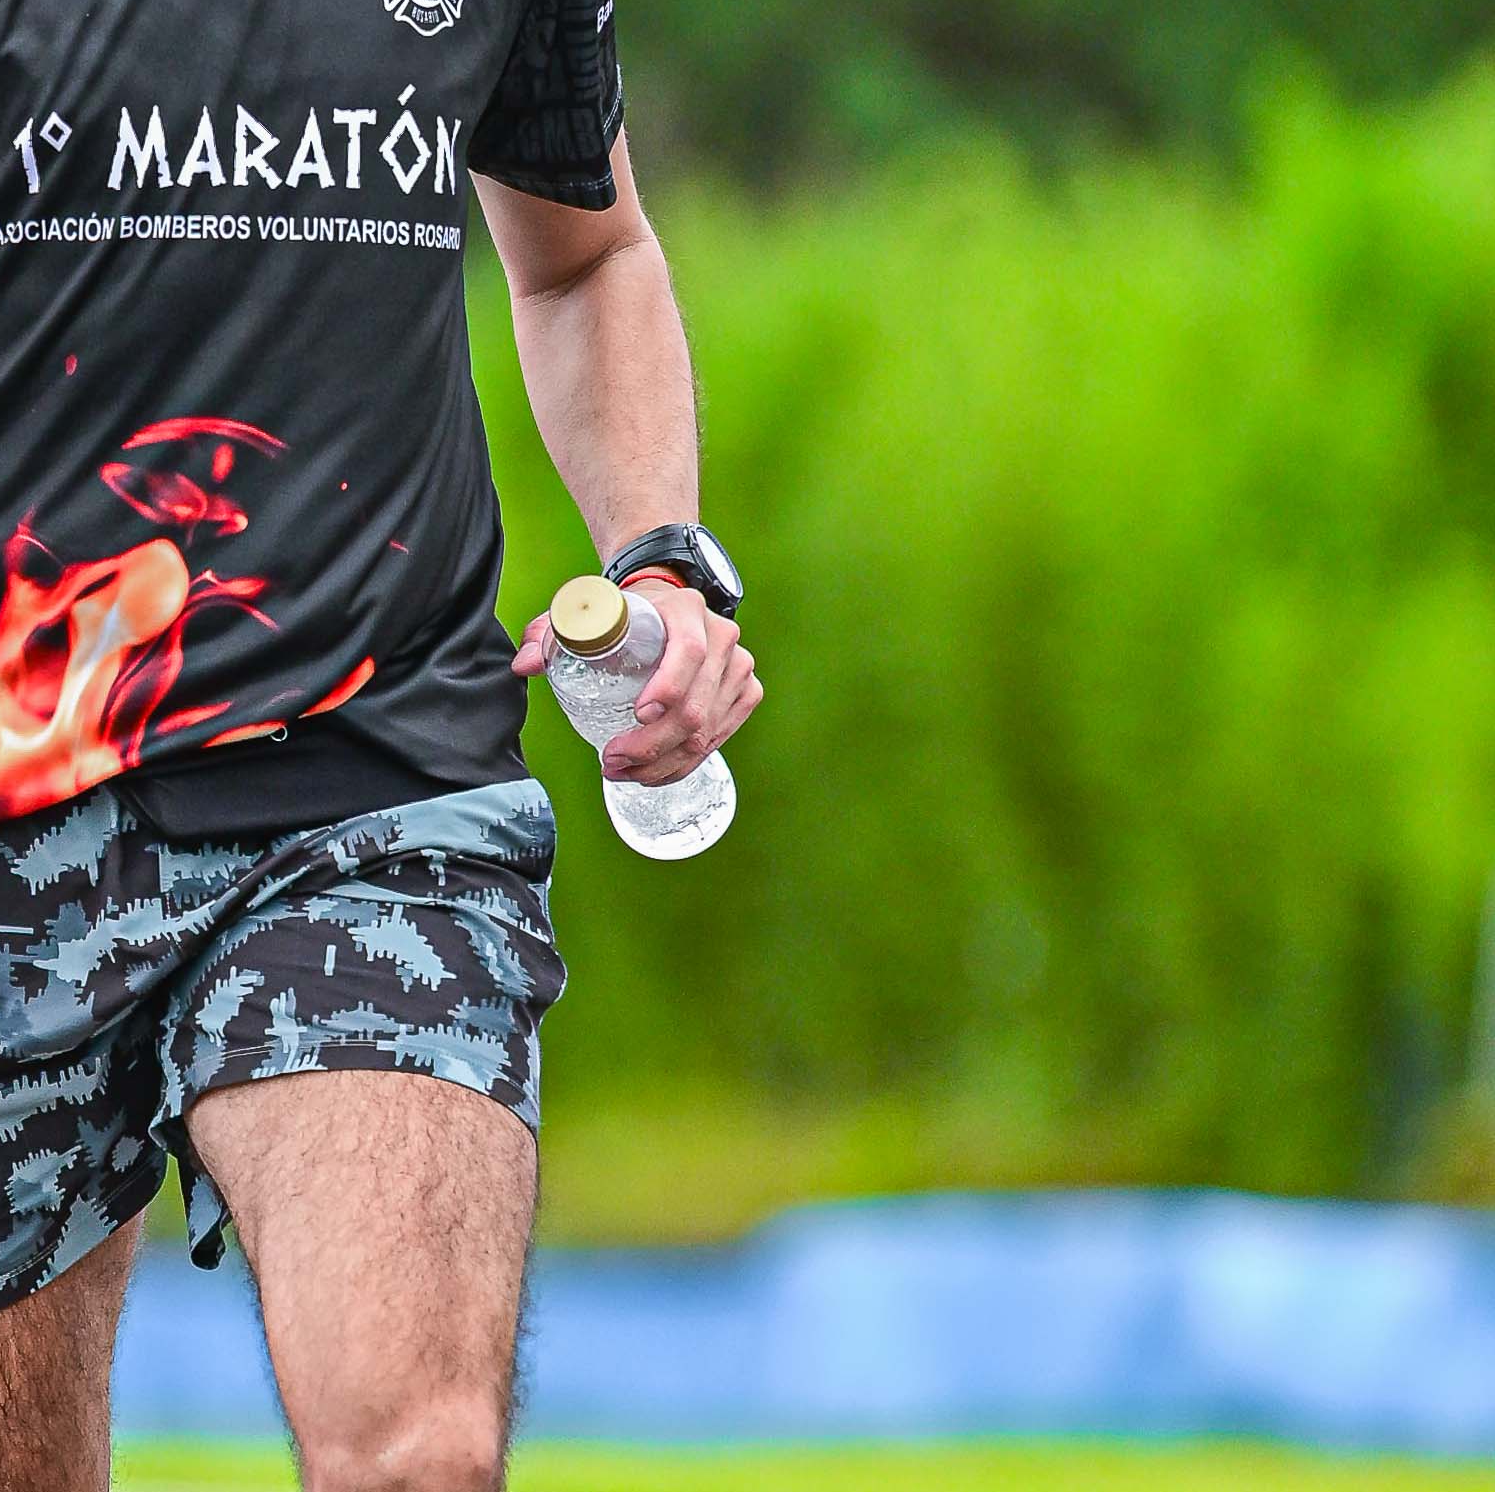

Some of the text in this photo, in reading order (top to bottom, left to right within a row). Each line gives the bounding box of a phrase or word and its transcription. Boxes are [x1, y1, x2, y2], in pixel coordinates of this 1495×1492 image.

[107, 84, 462, 196] MARATÓN
[119, 214, 252, 241] BOMBEROS
[257, 215, 411, 246] VOLUNTARIOS
